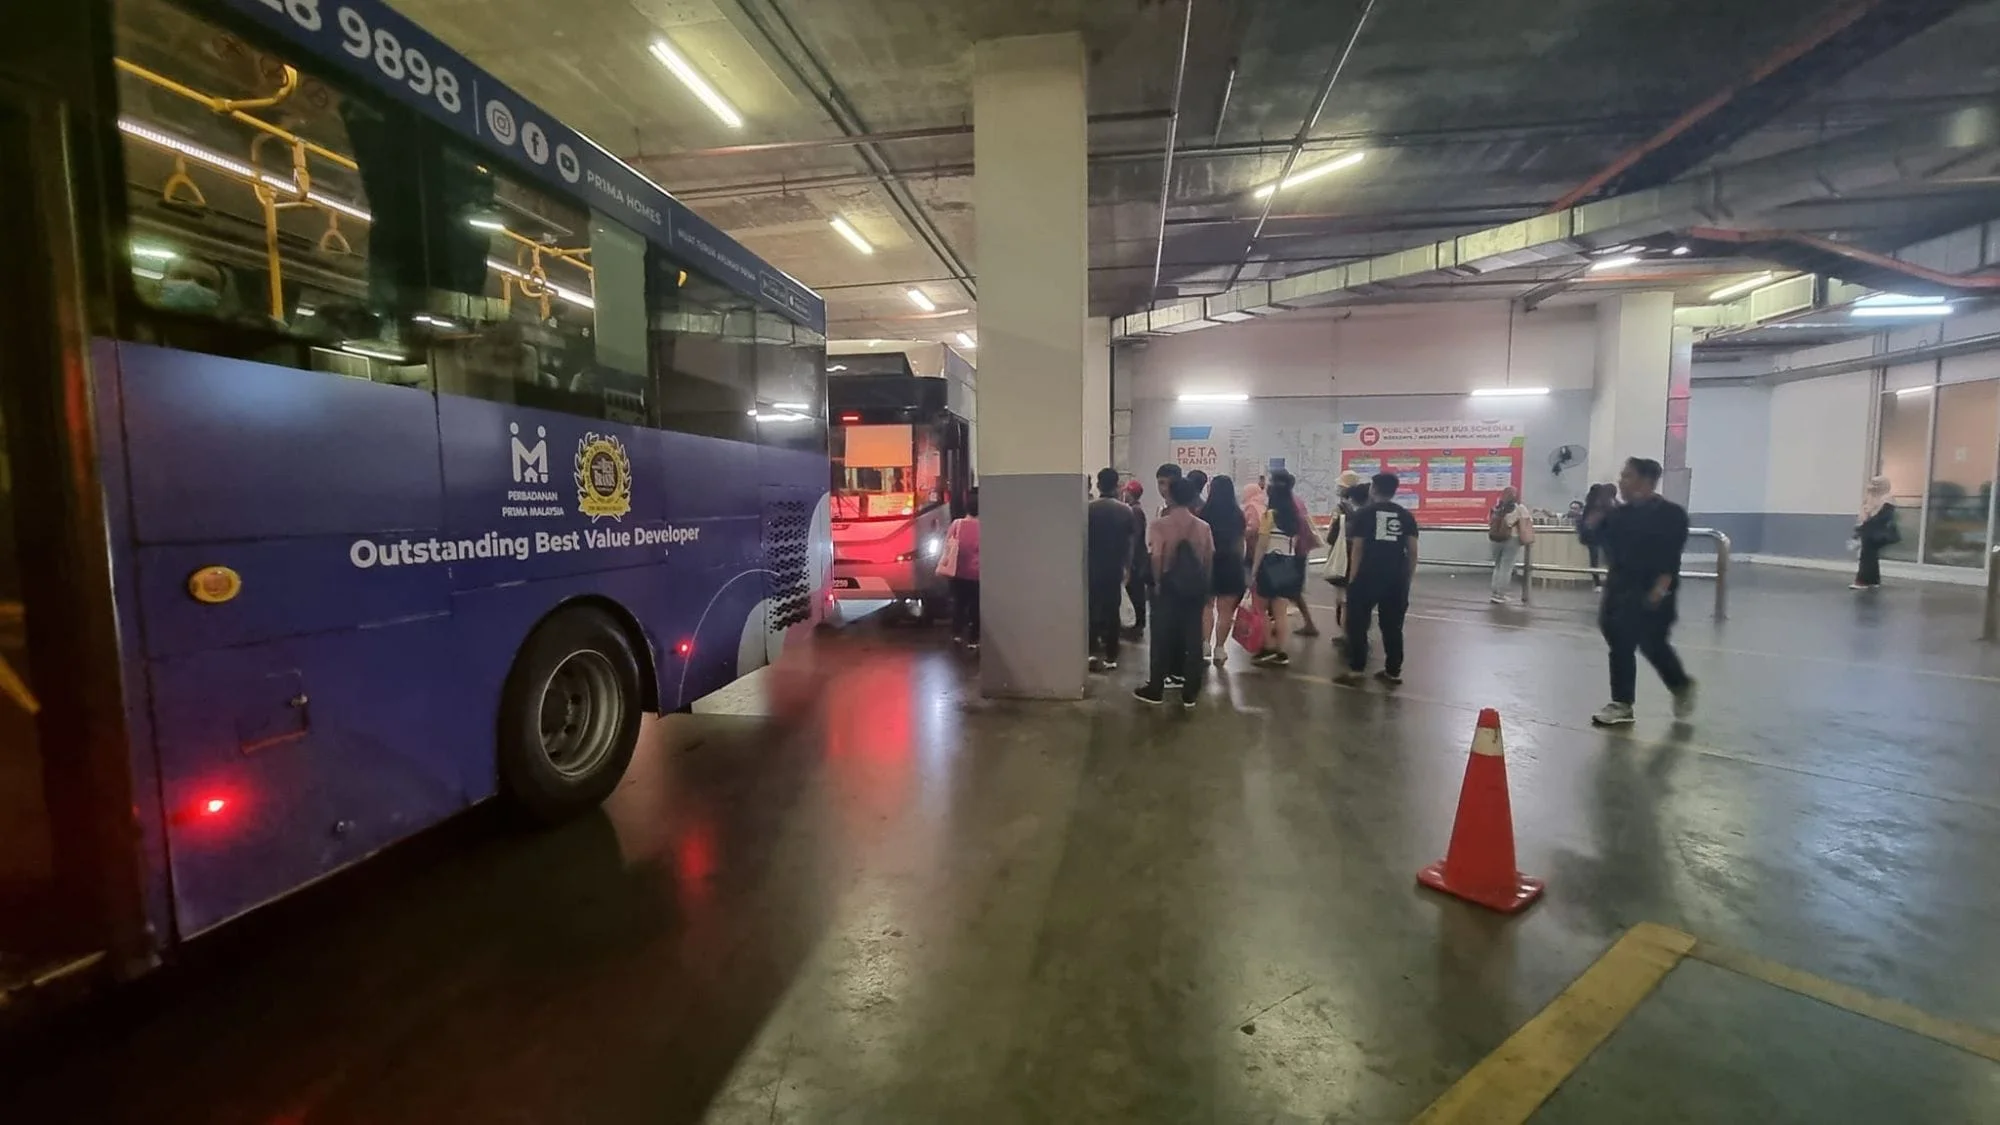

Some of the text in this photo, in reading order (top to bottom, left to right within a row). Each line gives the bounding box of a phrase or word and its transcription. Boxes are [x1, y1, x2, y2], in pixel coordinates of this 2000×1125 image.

[259, 0, 461, 114] 8 9898
[626, 193, 662, 226] HOMES
[1452, 425, 1470, 433] BUS
[1471, 424, 1515, 433] SCHEDULE
[1176, 446, 1218, 458] PETA
[1177, 457, 1216, 465] TRANSIT
[507, 490, 559, 501] PERBADANAN
[529, 506, 565, 517] MALAYSIA
[350, 525, 700, 568] Outstanding Best Value Developer
